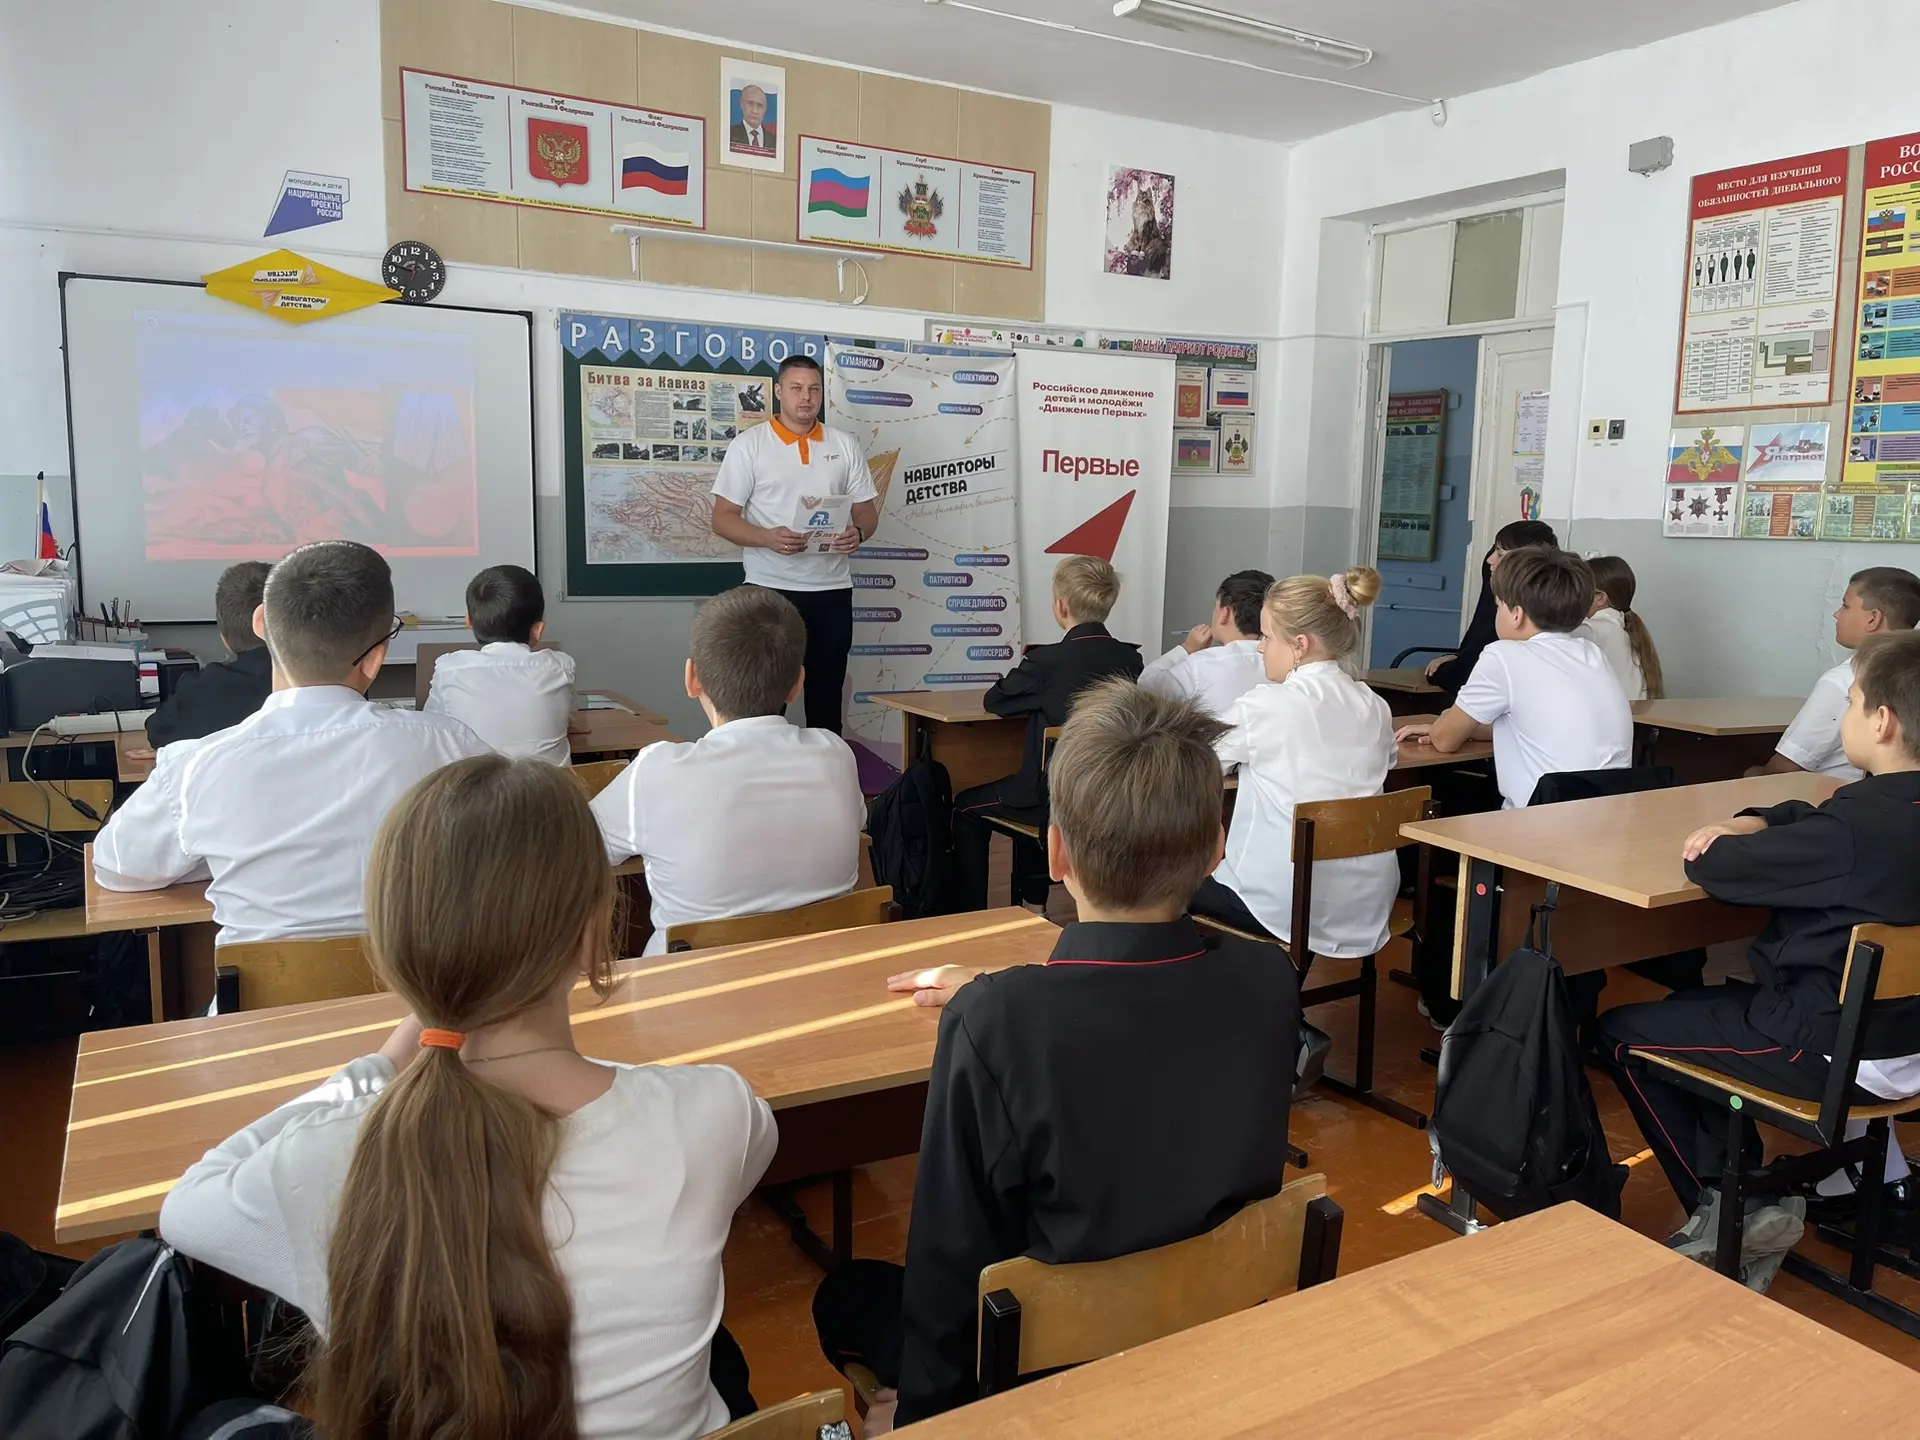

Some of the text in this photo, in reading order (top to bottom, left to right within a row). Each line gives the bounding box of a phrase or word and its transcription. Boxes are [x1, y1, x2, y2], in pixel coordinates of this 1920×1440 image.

[1717, 165, 1822, 191] МЕСТО ДЛЯ ИЗУЧЕНИЯ
[288, 188, 341, 203] НАЦИОНАЛЬНЫЕ
[1698, 176, 1841, 208] ОБЯЗАННОСТЕЙ ДНЕВАЛЬНОГО
[311, 200, 341, 211] ПРОЕКТЫ
[317, 208, 341, 219] РОССИИ
[400, 248, 407, 256] 11
[411, 247, 420, 255] 12
[425, 252, 429, 260] 1
[392, 255, 402, 263] 10
[388, 265, 396, 273] 9
[430, 261, 437, 269] 2
[391, 276, 398, 284] 8
[432, 272, 439, 280] 3
[428, 282, 435, 290] 4
[409, 290, 417, 298] 6
[421, 289, 428, 297] 5
[281, 295, 327, 304] НАВИГАТОРЫ
[1132, 337, 1245, 359] ЮНЫЙ ПАТРИОТ РОДИНЫ
[840, 355, 879, 369] ГУМАНИЗМ
[587, 371, 706, 391] Битва за Кавказ
[954, 372, 998, 383] КОЛЛЕКТИВИЗМ
[1033, 382, 1154, 398] Российское движение
[1044, 394, 1077, 404] детей
[1087, 398, 1143, 408] молодёжи
[1038, 404, 1147, 418] «Движение Первых»
[1764, 446, 1779, 461] Я
[1775, 453, 1825, 462] патриот
[904, 456, 995, 484] НАВИГАТОРЫ
[1042, 448, 1139, 482] Первые
[906, 480, 967, 505] ДЕТСТВА
[875, 577, 893, 586] СЕМЬЯ
[929, 575, 967, 584] ПАТРИОТИЗМ
[948, 598, 1006, 609] СПРАВЕДЛИВОСТЬ
[970, 648, 1010, 657] МИЛОСЕРДИЕ
